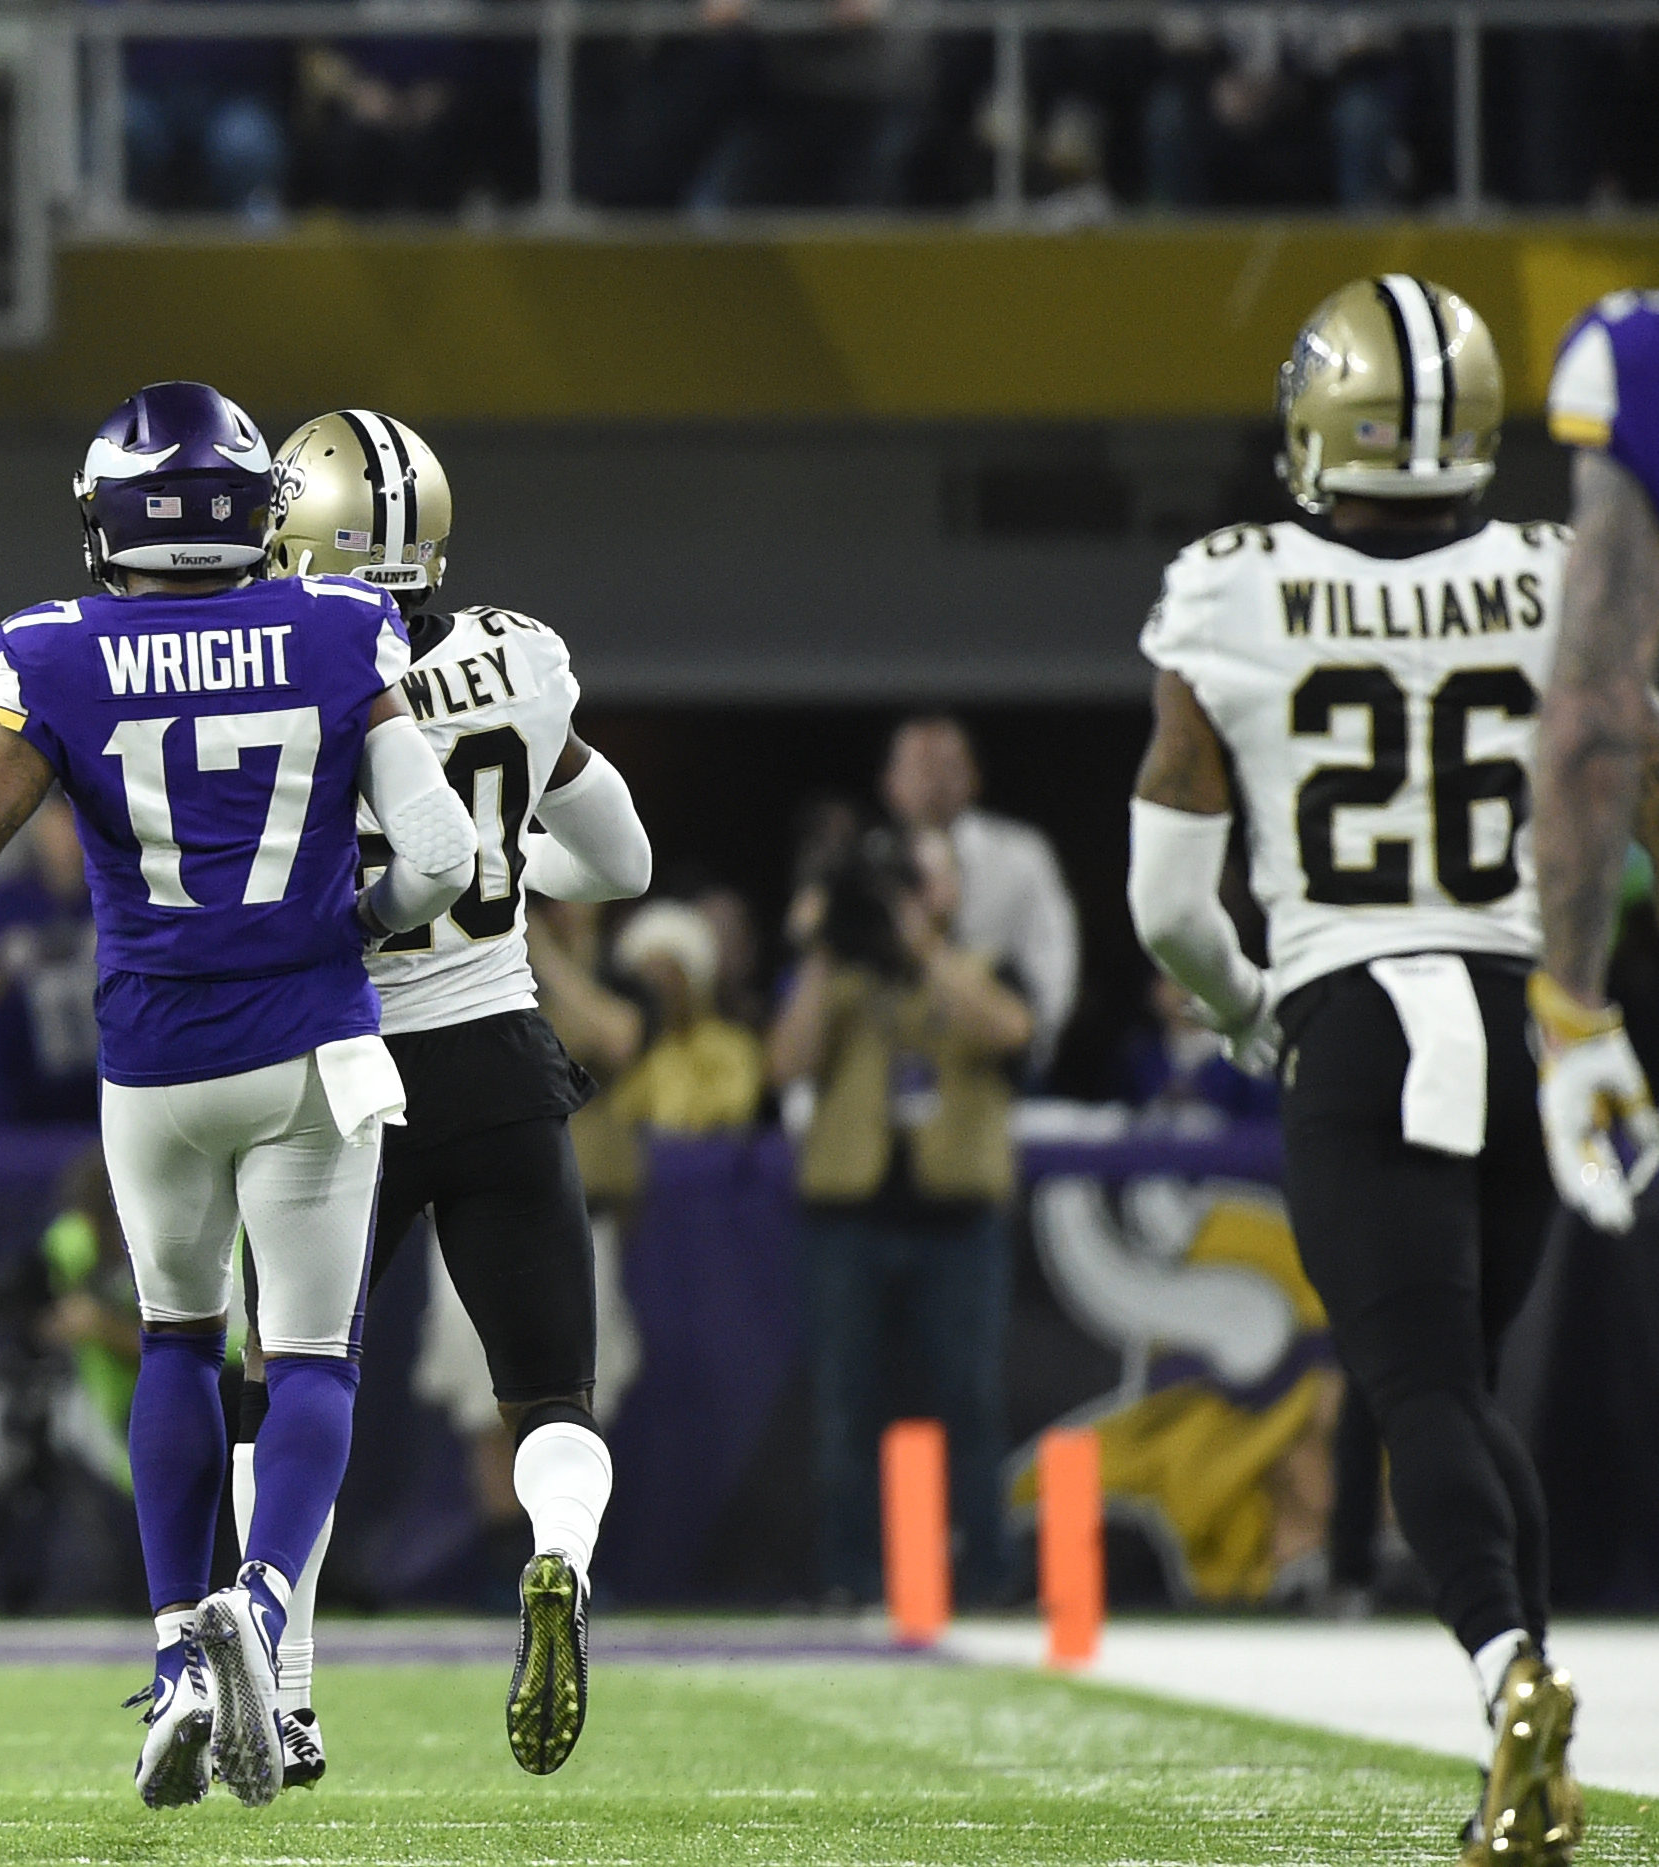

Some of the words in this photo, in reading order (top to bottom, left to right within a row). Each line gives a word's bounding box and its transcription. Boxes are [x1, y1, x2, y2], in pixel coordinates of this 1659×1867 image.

[363, 570, 419, 584] SAINTS
[1278, 572, 1546, 638] WILLIAMS
[98, 624, 292, 696] WRIGHT
[101, 706, 322, 908] 17
[1289, 660, 1544, 907] 26
[283, 1719, 321, 1762] NIKE
